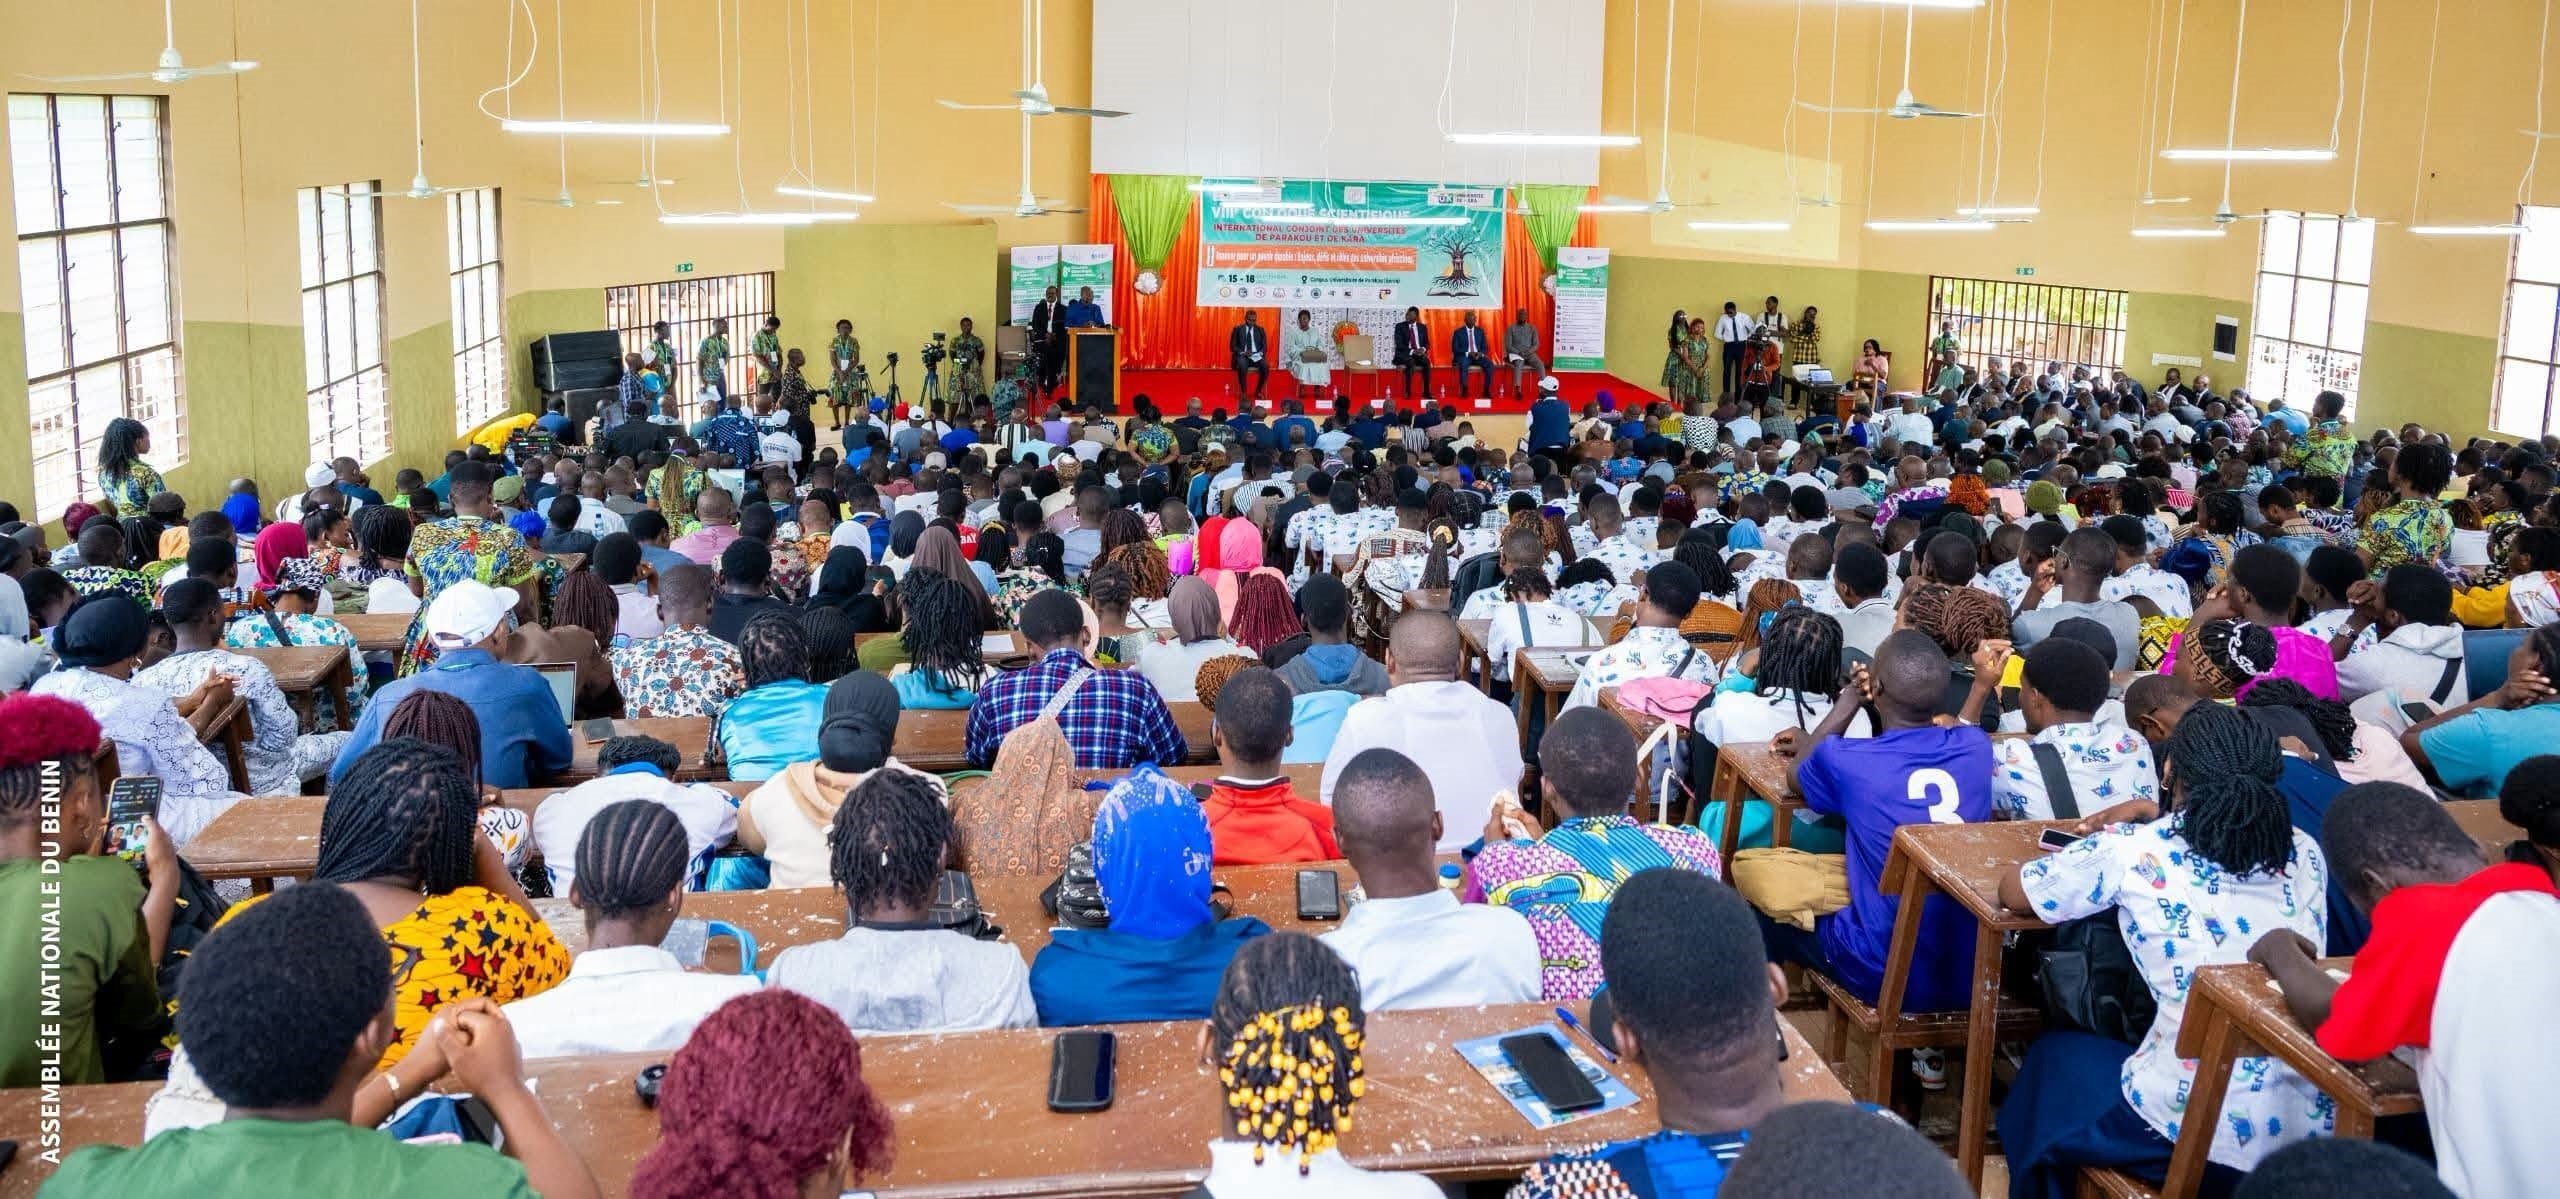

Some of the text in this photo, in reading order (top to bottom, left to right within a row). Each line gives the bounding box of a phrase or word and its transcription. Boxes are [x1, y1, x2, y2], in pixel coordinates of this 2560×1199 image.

[1213, 223, 1282, 233] INTERNATIONAL
[1287, 224, 1330, 233] CONJOINT
[1332, 225, 1349, 233] DES
[1255, 233, 1267, 241] DE
[1270, 233, 1312, 242] PARAKOU
[1314, 234, 1325, 242] ET
[1340, 235, 1365, 243] KARA
[1228, 275, 1238, 283] 15
[1245, 275, 1255, 283] 18
